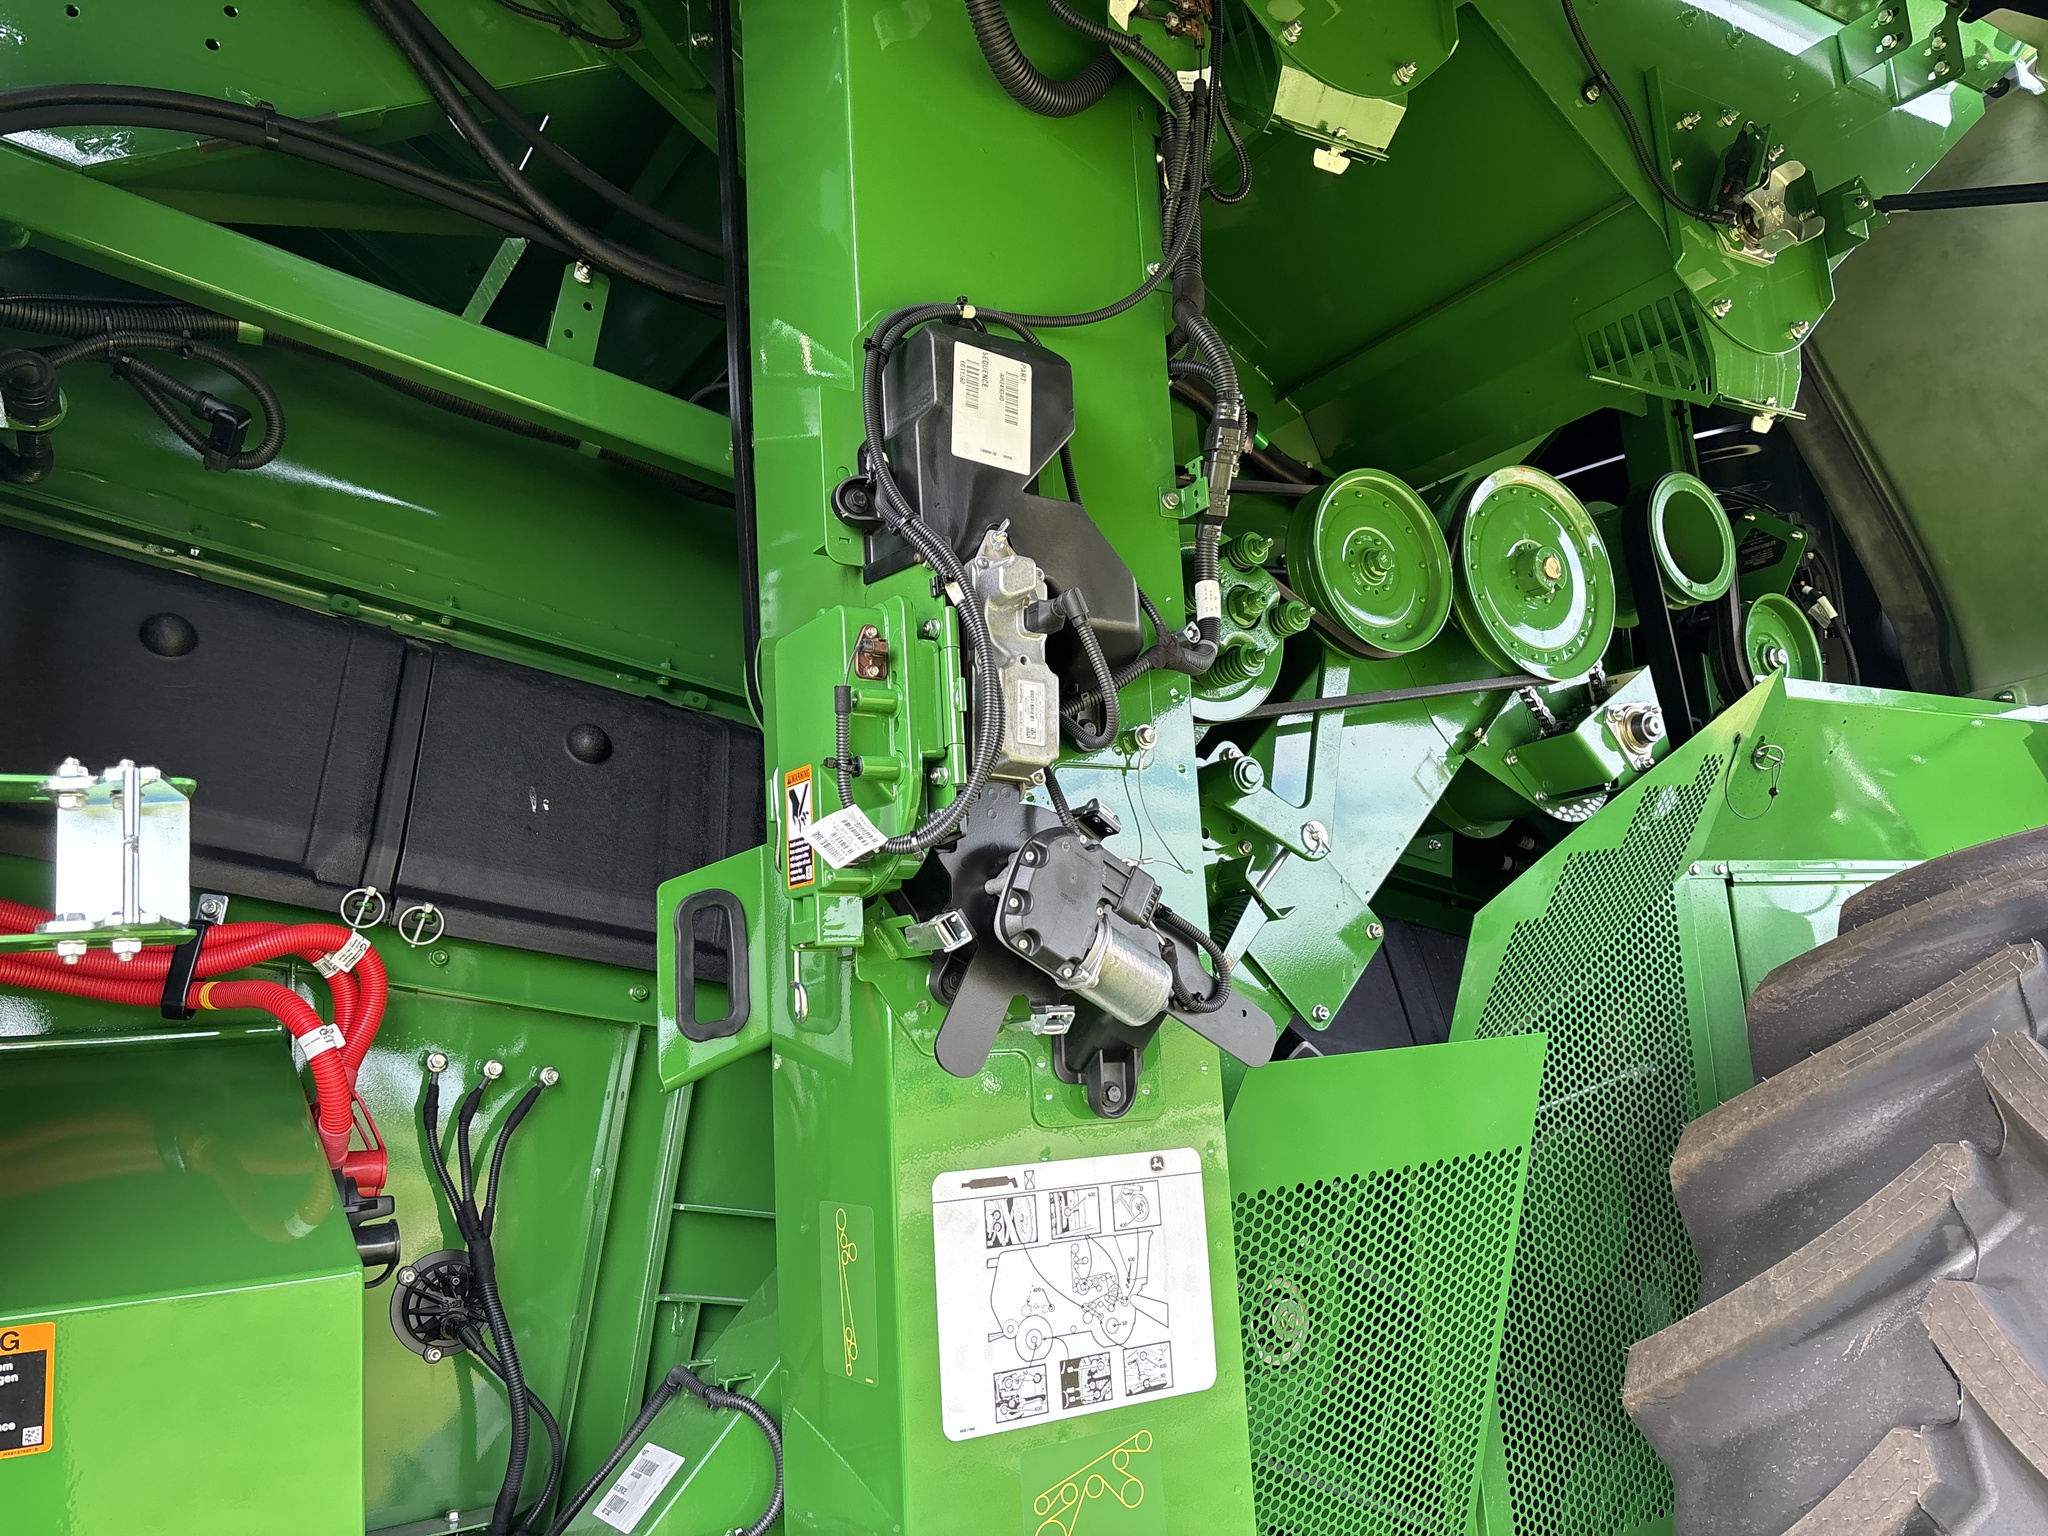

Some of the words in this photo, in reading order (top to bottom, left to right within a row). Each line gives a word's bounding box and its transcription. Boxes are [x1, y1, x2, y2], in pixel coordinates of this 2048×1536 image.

[981, 351, 989, 391] SEQUENCE:
[791, 768, 810, 783] WARNING
[0, 1331, 20, 1352] G
